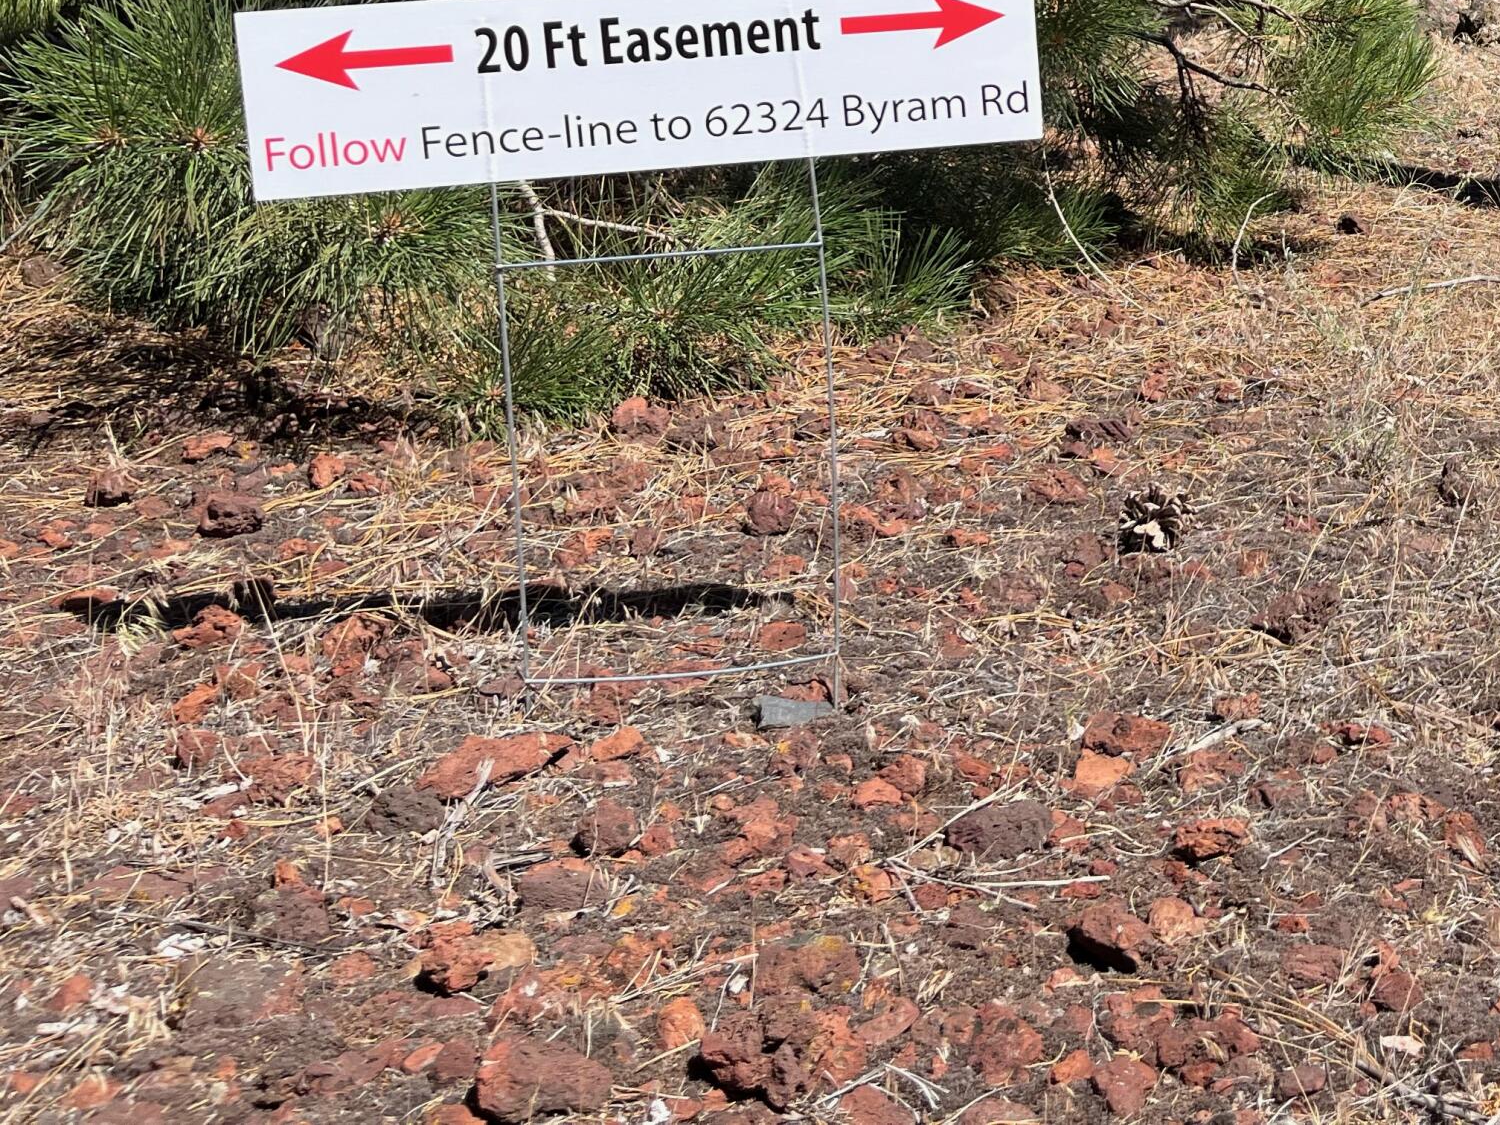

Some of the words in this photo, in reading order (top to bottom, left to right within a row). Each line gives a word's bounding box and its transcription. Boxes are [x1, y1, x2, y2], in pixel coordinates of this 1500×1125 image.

[475, 25, 529, 73] 20
[543, 19, 588, 68] Ft
[600, 8, 821, 65] Easement
[265, 131, 407, 172] Follow
[422, 114, 638, 161] Fence-line
[649, 114, 692, 142] to
[705, 95, 830, 137] 62324
[842, 92, 967, 134] Byram
[981, 80, 1029, 116] Rd
